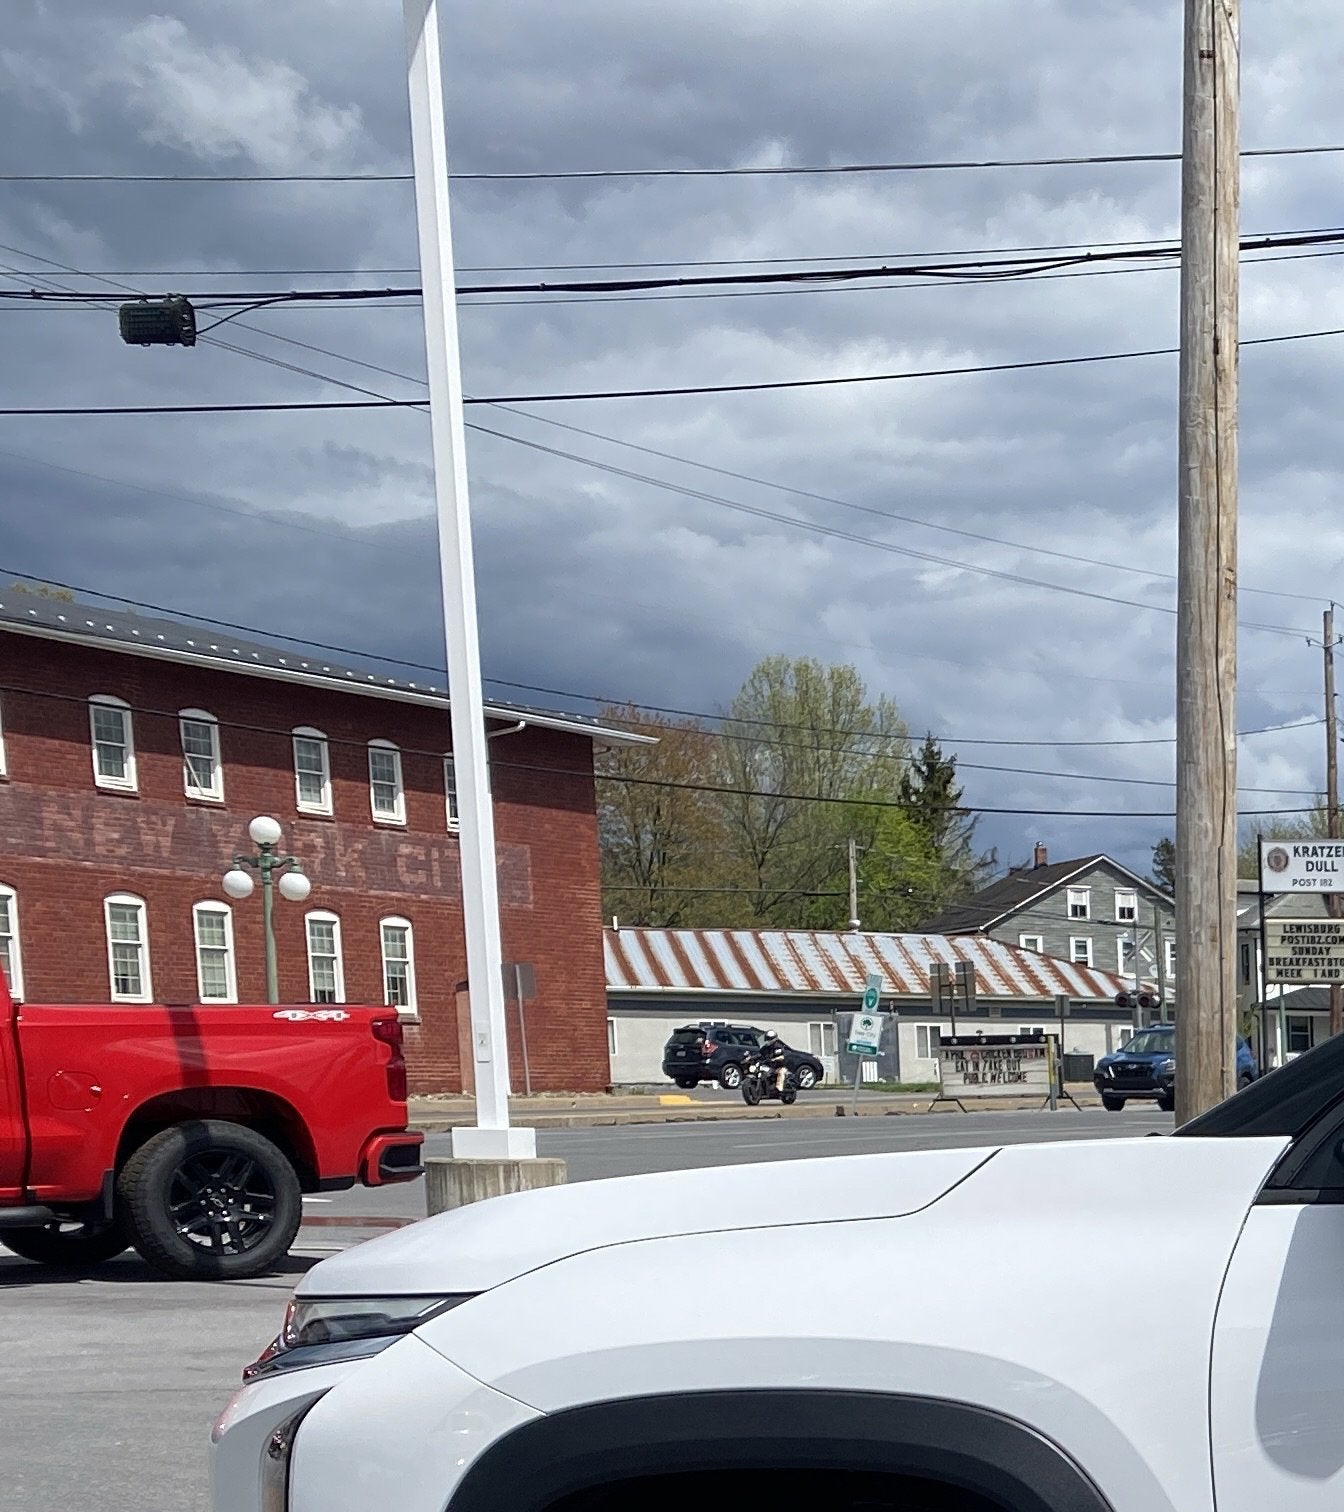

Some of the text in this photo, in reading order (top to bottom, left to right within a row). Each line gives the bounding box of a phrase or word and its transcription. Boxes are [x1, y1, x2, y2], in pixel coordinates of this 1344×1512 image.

[42, 803, 178, 859] NEW
[211, 823, 368, 884] YRK
[1305, 860, 1339, 872] DULL
[1292, 878, 1333, 887] POST 182
[1283, 924, 1341, 934] LEWISBURG
[1291, 946, 1331, 956] SUNDAY
[1276, 968, 1302, 978] WEEK
[1320, 968, 1340, 978] AND
[955, 1060, 969, 1072] EAT
[982, 1059, 1003, 1072] TAKE
[1006, 1058, 1021, 1071] OUT
[990, 1071, 1028, 1084] WELCOME
